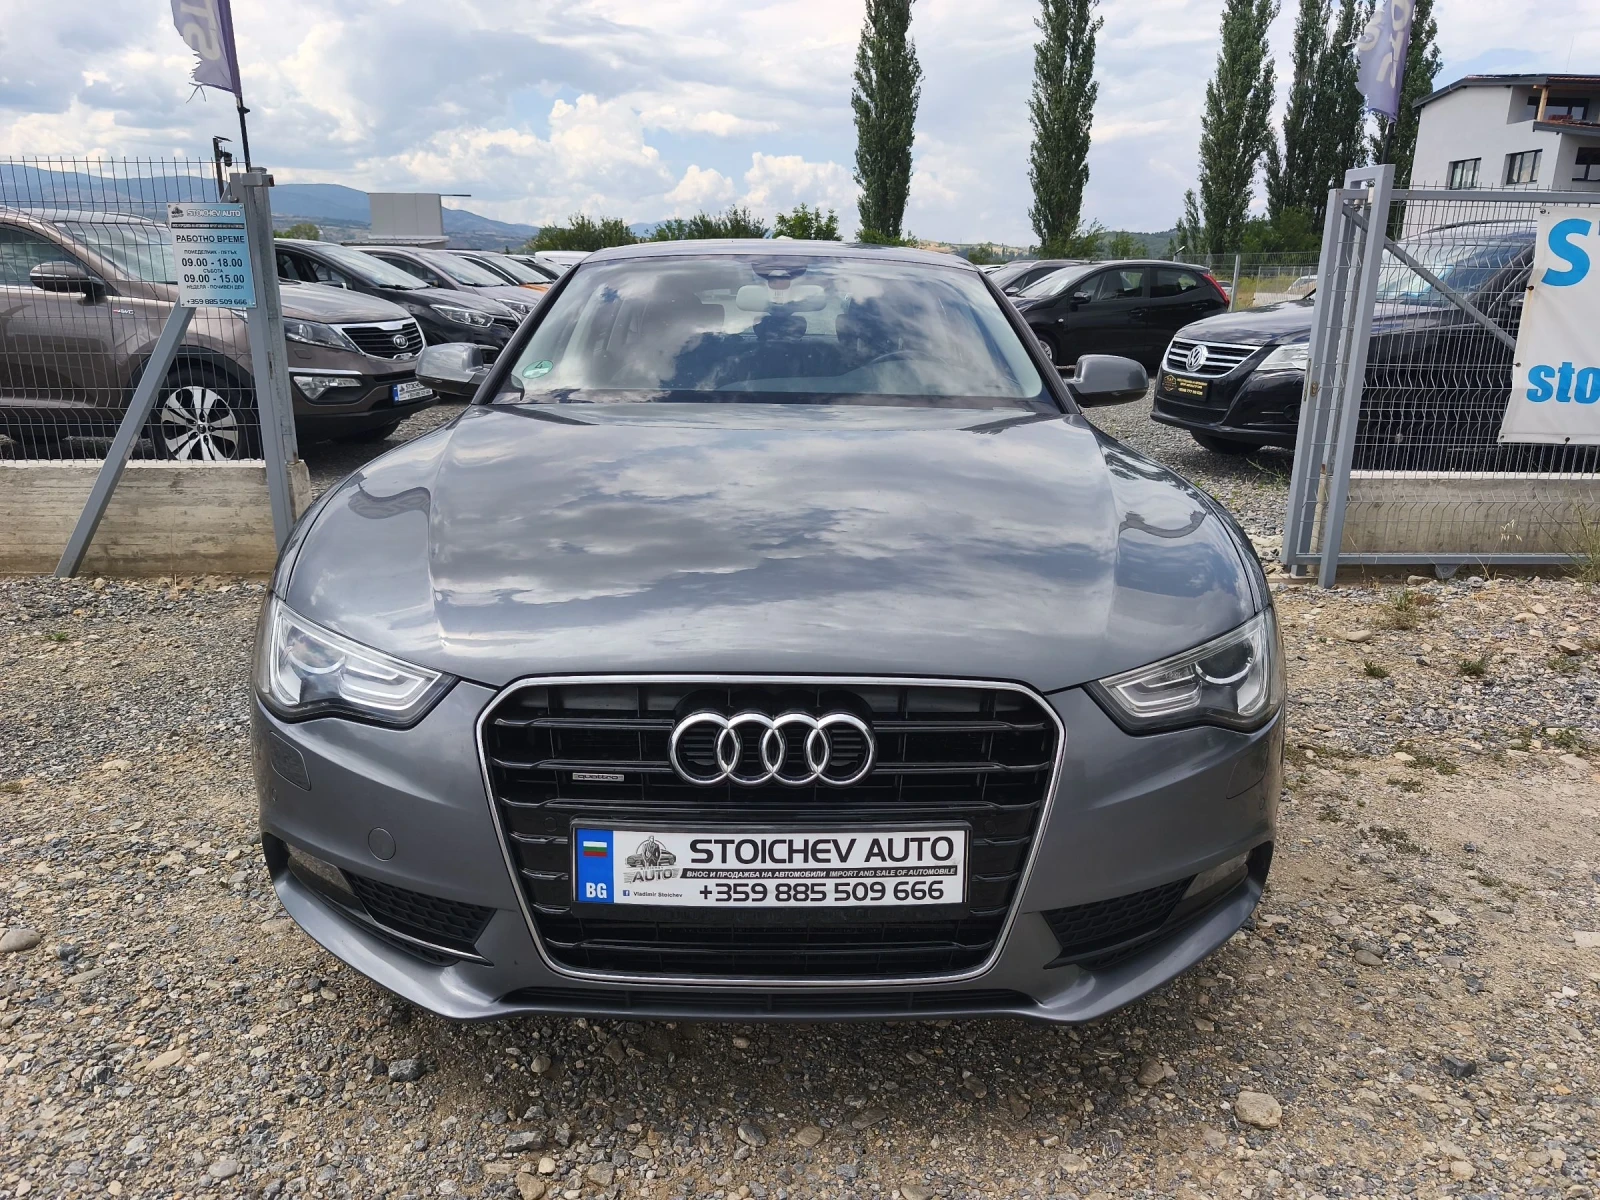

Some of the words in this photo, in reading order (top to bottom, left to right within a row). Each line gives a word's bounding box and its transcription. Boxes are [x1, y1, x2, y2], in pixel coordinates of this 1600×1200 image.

[187, 209, 220, 217] STOICHEV
[176, 234, 215, 243] РАБОТНО
[217, 235, 245, 243] ВРЕМЕ
[1541, 218, 1600, 287] S
[182, 258, 208, 267] 09.00
[217, 258, 243, 267] 18.00
[184, 274, 210, 283] 09.00
[219, 274, 245, 283] 15.00
[1526, 362, 1600, 404] sto
[689, 838, 857, 864] STOICHEV
[864, 836, 955, 863] AUTO
[632, 869, 673, 882] AUTO
[686, 870, 709, 878] ВНОС
[716, 871, 760, 879] ПРОДАЖБА
[585, 882, 607, 899] BG
[699, 882, 768, 902] +359
[775, 883, 827, 902] 885
[834, 881, 886, 902] 509
[893, 880, 944, 901] 666
